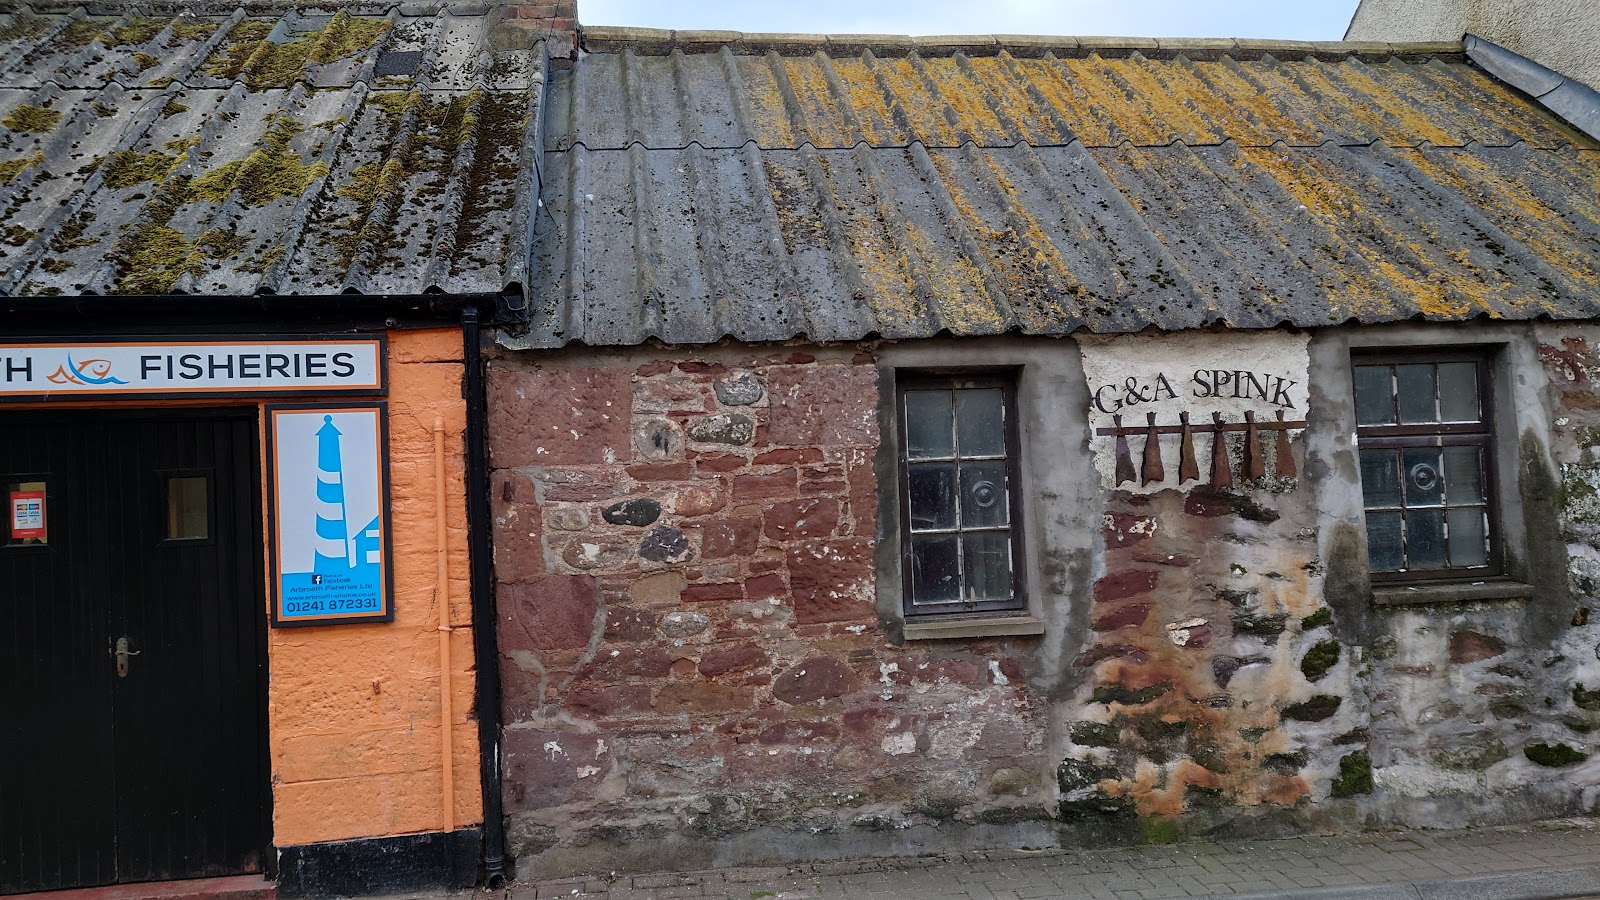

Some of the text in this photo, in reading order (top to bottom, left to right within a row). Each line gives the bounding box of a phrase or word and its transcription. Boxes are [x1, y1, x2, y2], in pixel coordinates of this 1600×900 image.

[140, 352, 356, 380] FISHERIES
[1093, 369, 1297, 414] G&A SPINK
[287, 591, 376, 601] www.arbroath-smokie.co.uk
[290, 585, 323, 593] Arbroath
[287, 598, 377, 612] 01241 872331
